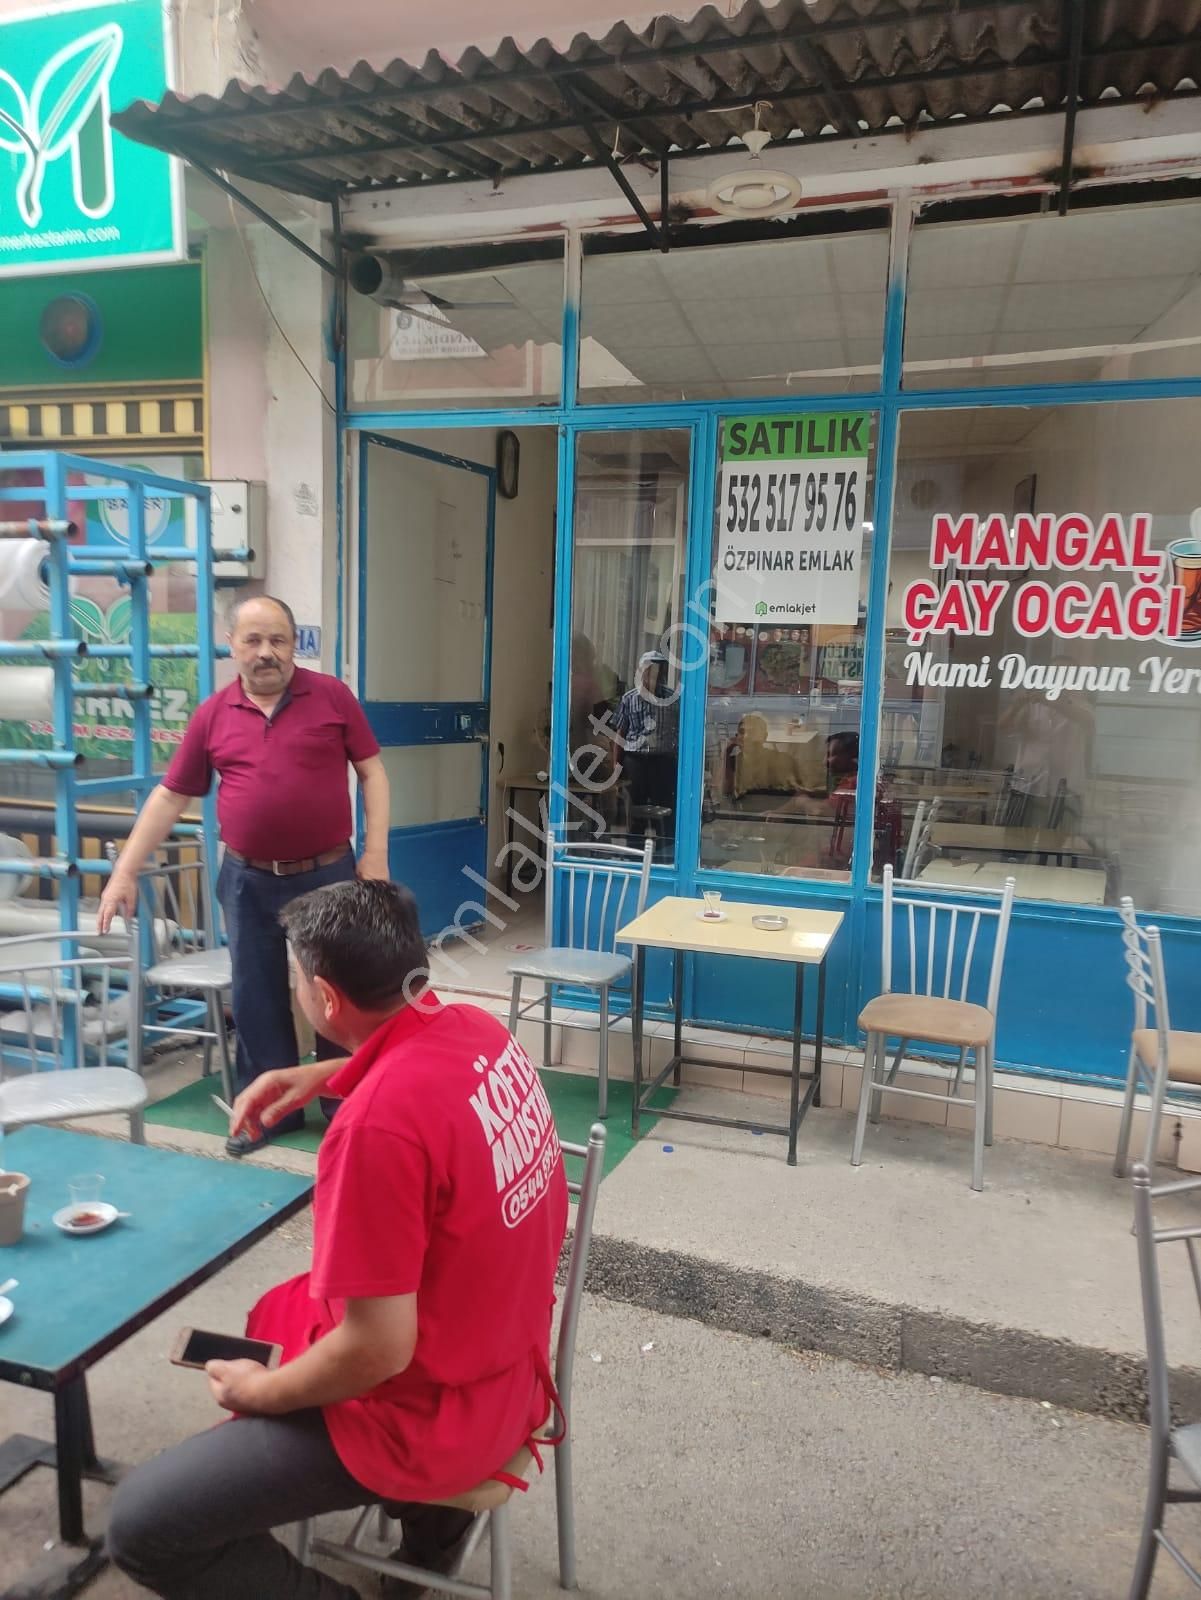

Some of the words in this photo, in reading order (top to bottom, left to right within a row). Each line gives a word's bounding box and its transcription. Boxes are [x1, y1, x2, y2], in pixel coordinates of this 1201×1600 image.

[728, 417, 865, 456] SATILIK
[726, 473, 761, 533] 532
[765, 473, 801, 533] 517
[804, 471, 829, 532] 95
[832, 470, 858, 531] 76
[723, 545, 794, 571] ÖZPINAR
[799, 549, 854, 571] EMLAK
[931, 514, 1164, 569] MANGAL
[769, 601, 816, 617] emlakjet
[903, 580, 1007, 645] ÇAY
[1014, 571, 1184, 639] OCAĞI
[903, 651, 992, 687] Nami
[998, 653, 1130, 701] Dayının
[1138, 656, 1201, 694] Yer
